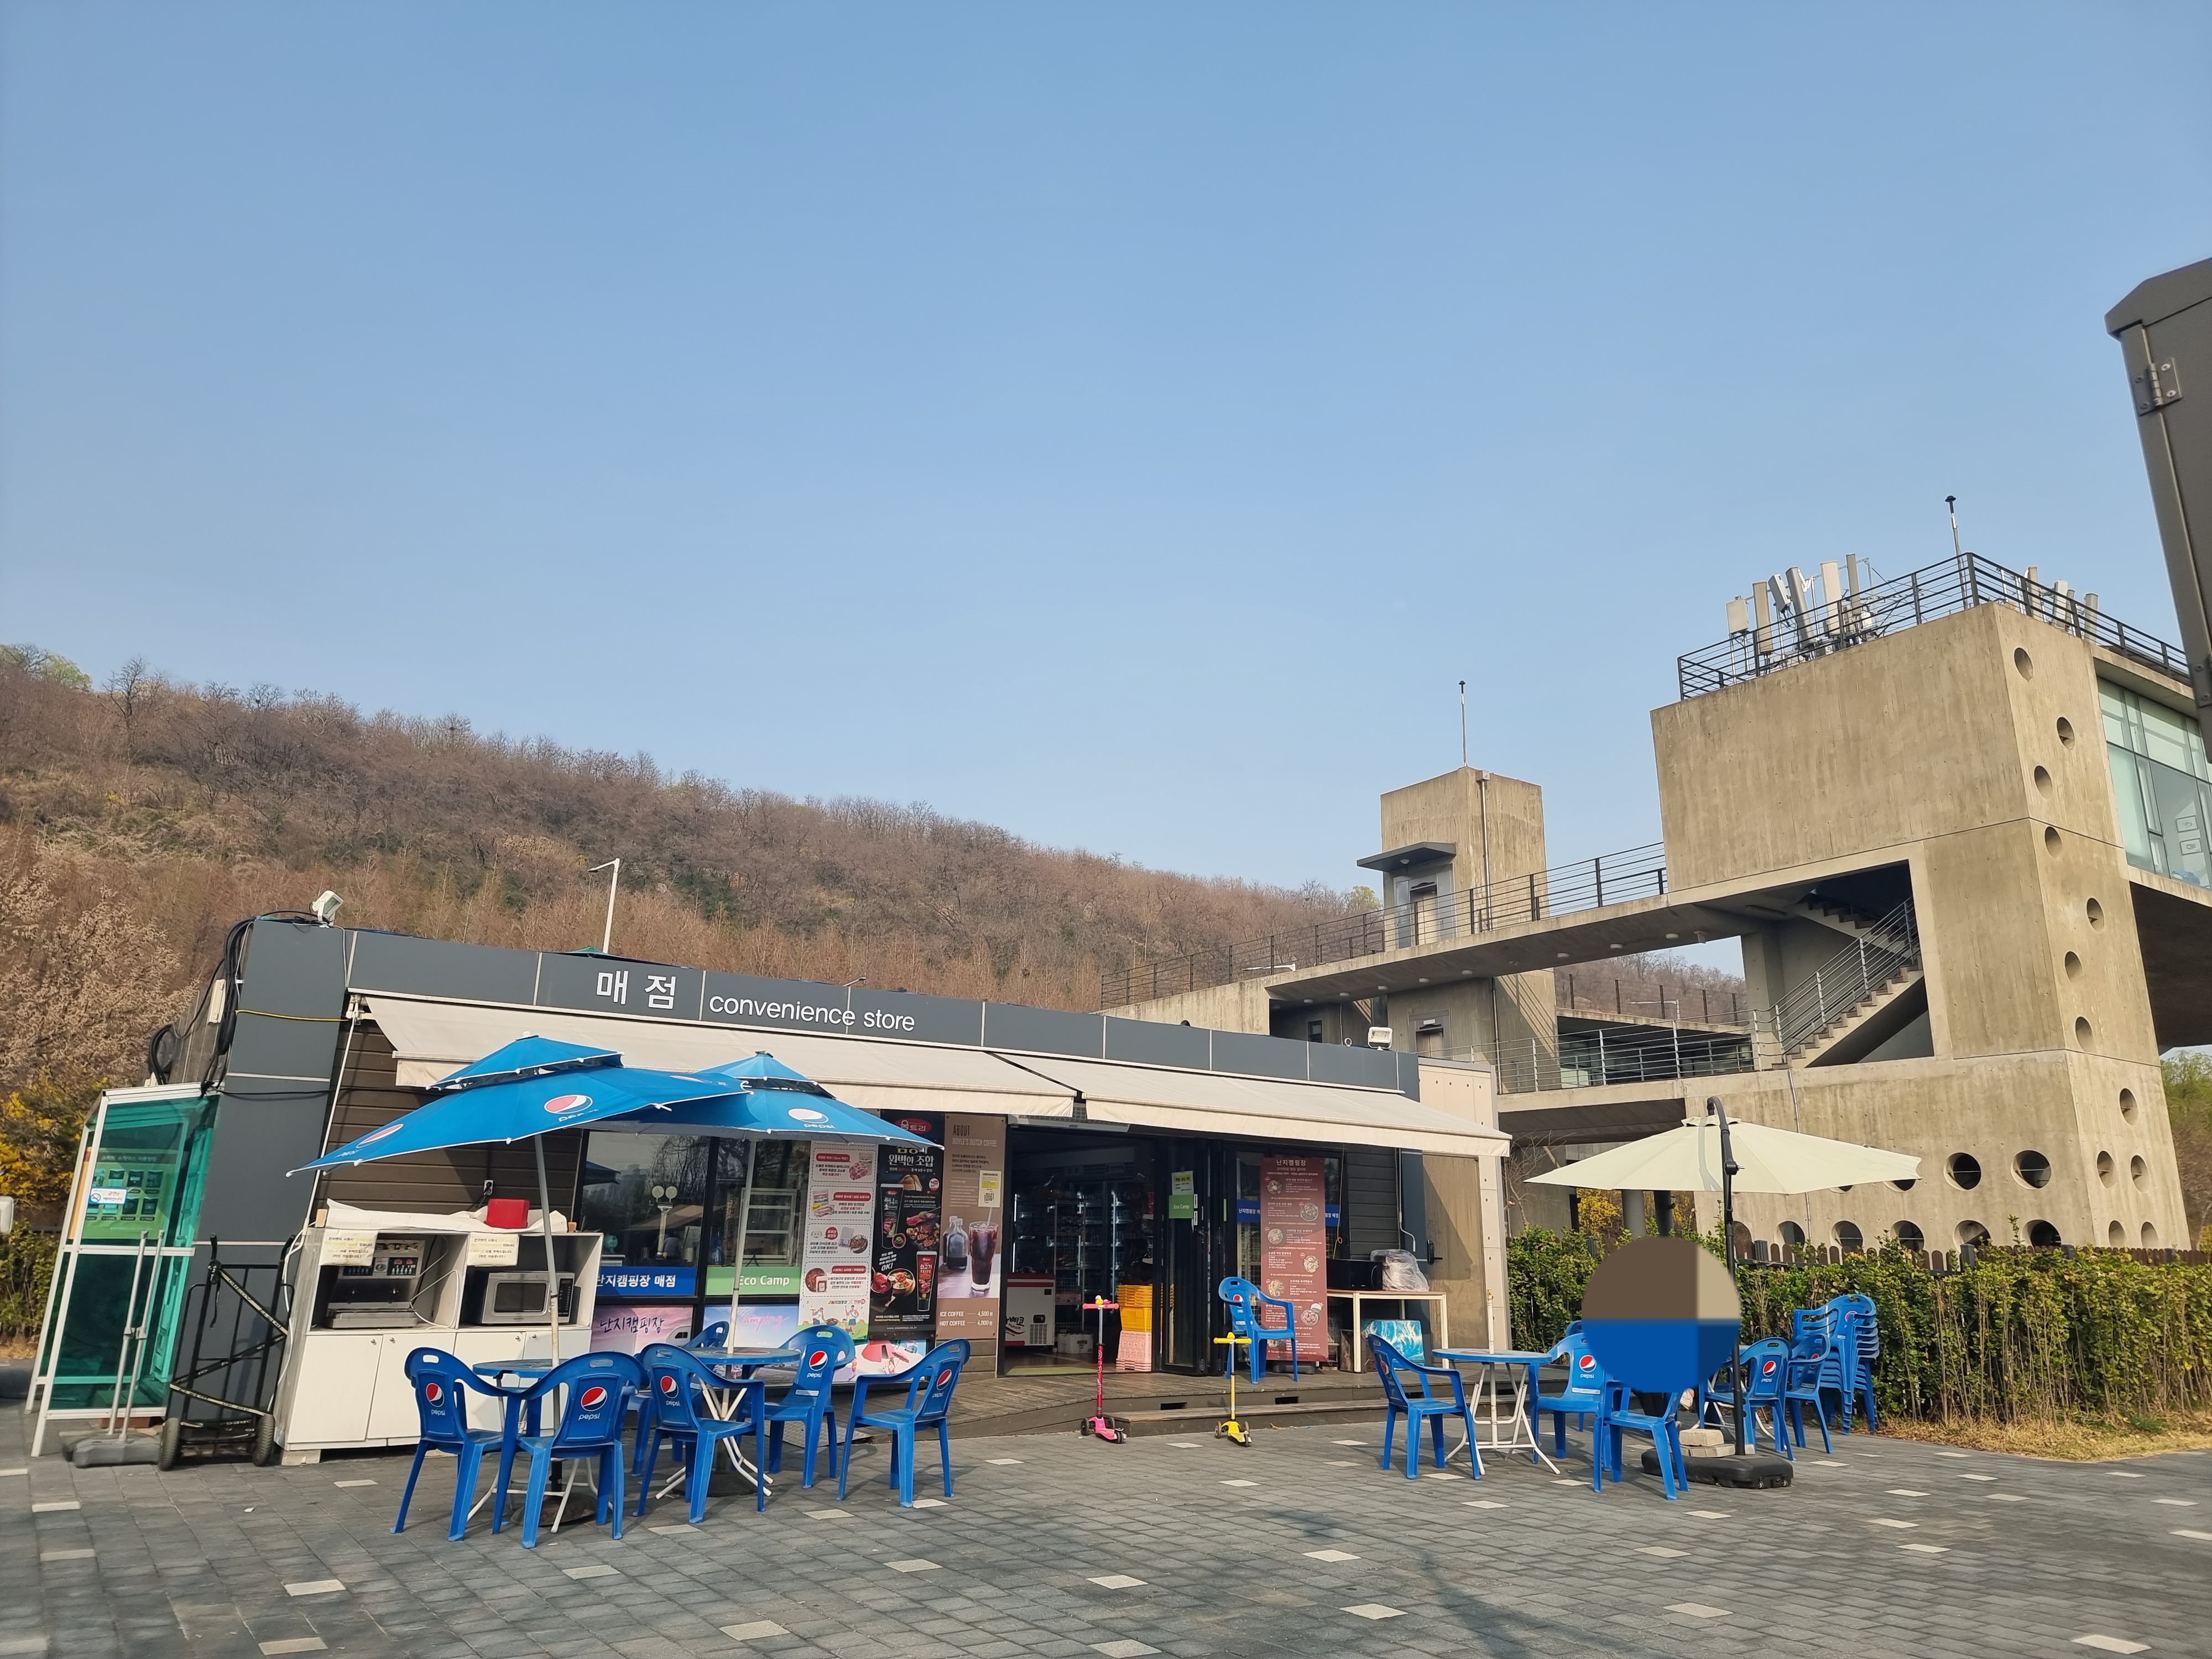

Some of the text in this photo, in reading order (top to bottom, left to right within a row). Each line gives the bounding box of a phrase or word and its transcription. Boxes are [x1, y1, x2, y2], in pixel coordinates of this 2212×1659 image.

[709, 996, 915, 1031] convenience store
[900, 1120, 926, 1131] 움트리
[952, 1125, 971, 1135] ABOUT
[916, 1155, 934, 1167] 조합
[881, 1262, 893, 1271] OK!
[597, 1274, 676, 1287] 난지캠핑장 매점
[739, 1275, 790, 1286] Eco Camp
[600, 1316, 665, 1333] 난지캠핑장
[740, 1315, 787, 1332] amping
[578, 1413, 601, 1421] pepsi
